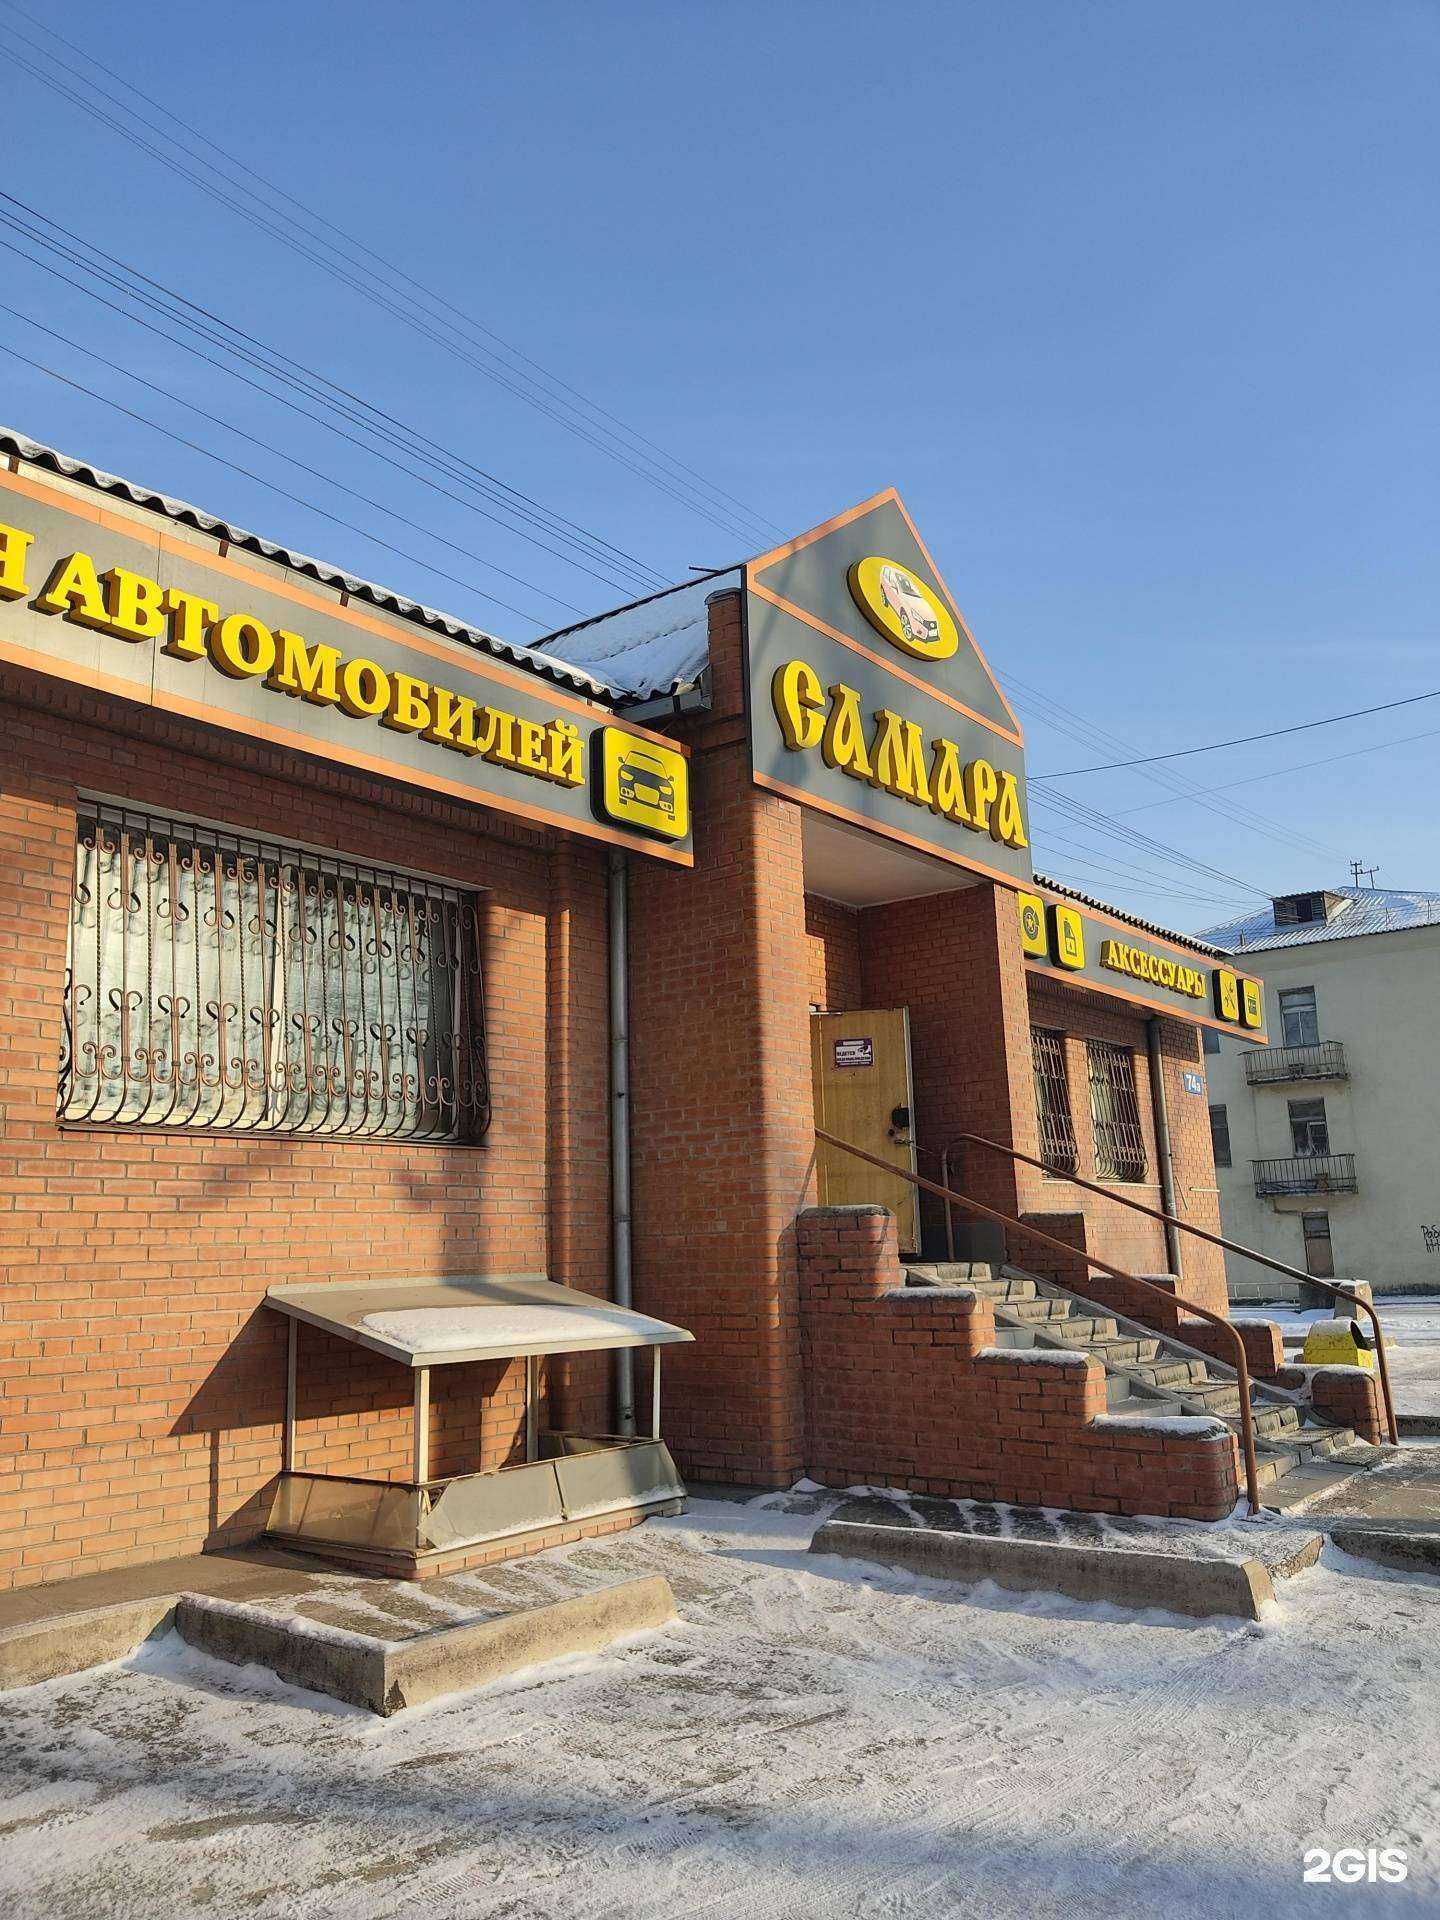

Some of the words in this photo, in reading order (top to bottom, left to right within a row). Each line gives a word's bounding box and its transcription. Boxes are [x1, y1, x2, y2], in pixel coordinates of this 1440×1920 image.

[44, 552, 587, 787] АВТОМОБИЛЕЙ
[774, 660, 1029, 849] САМАРА
[1106, 940, 1207, 998] АКСЕССУАРЫ
